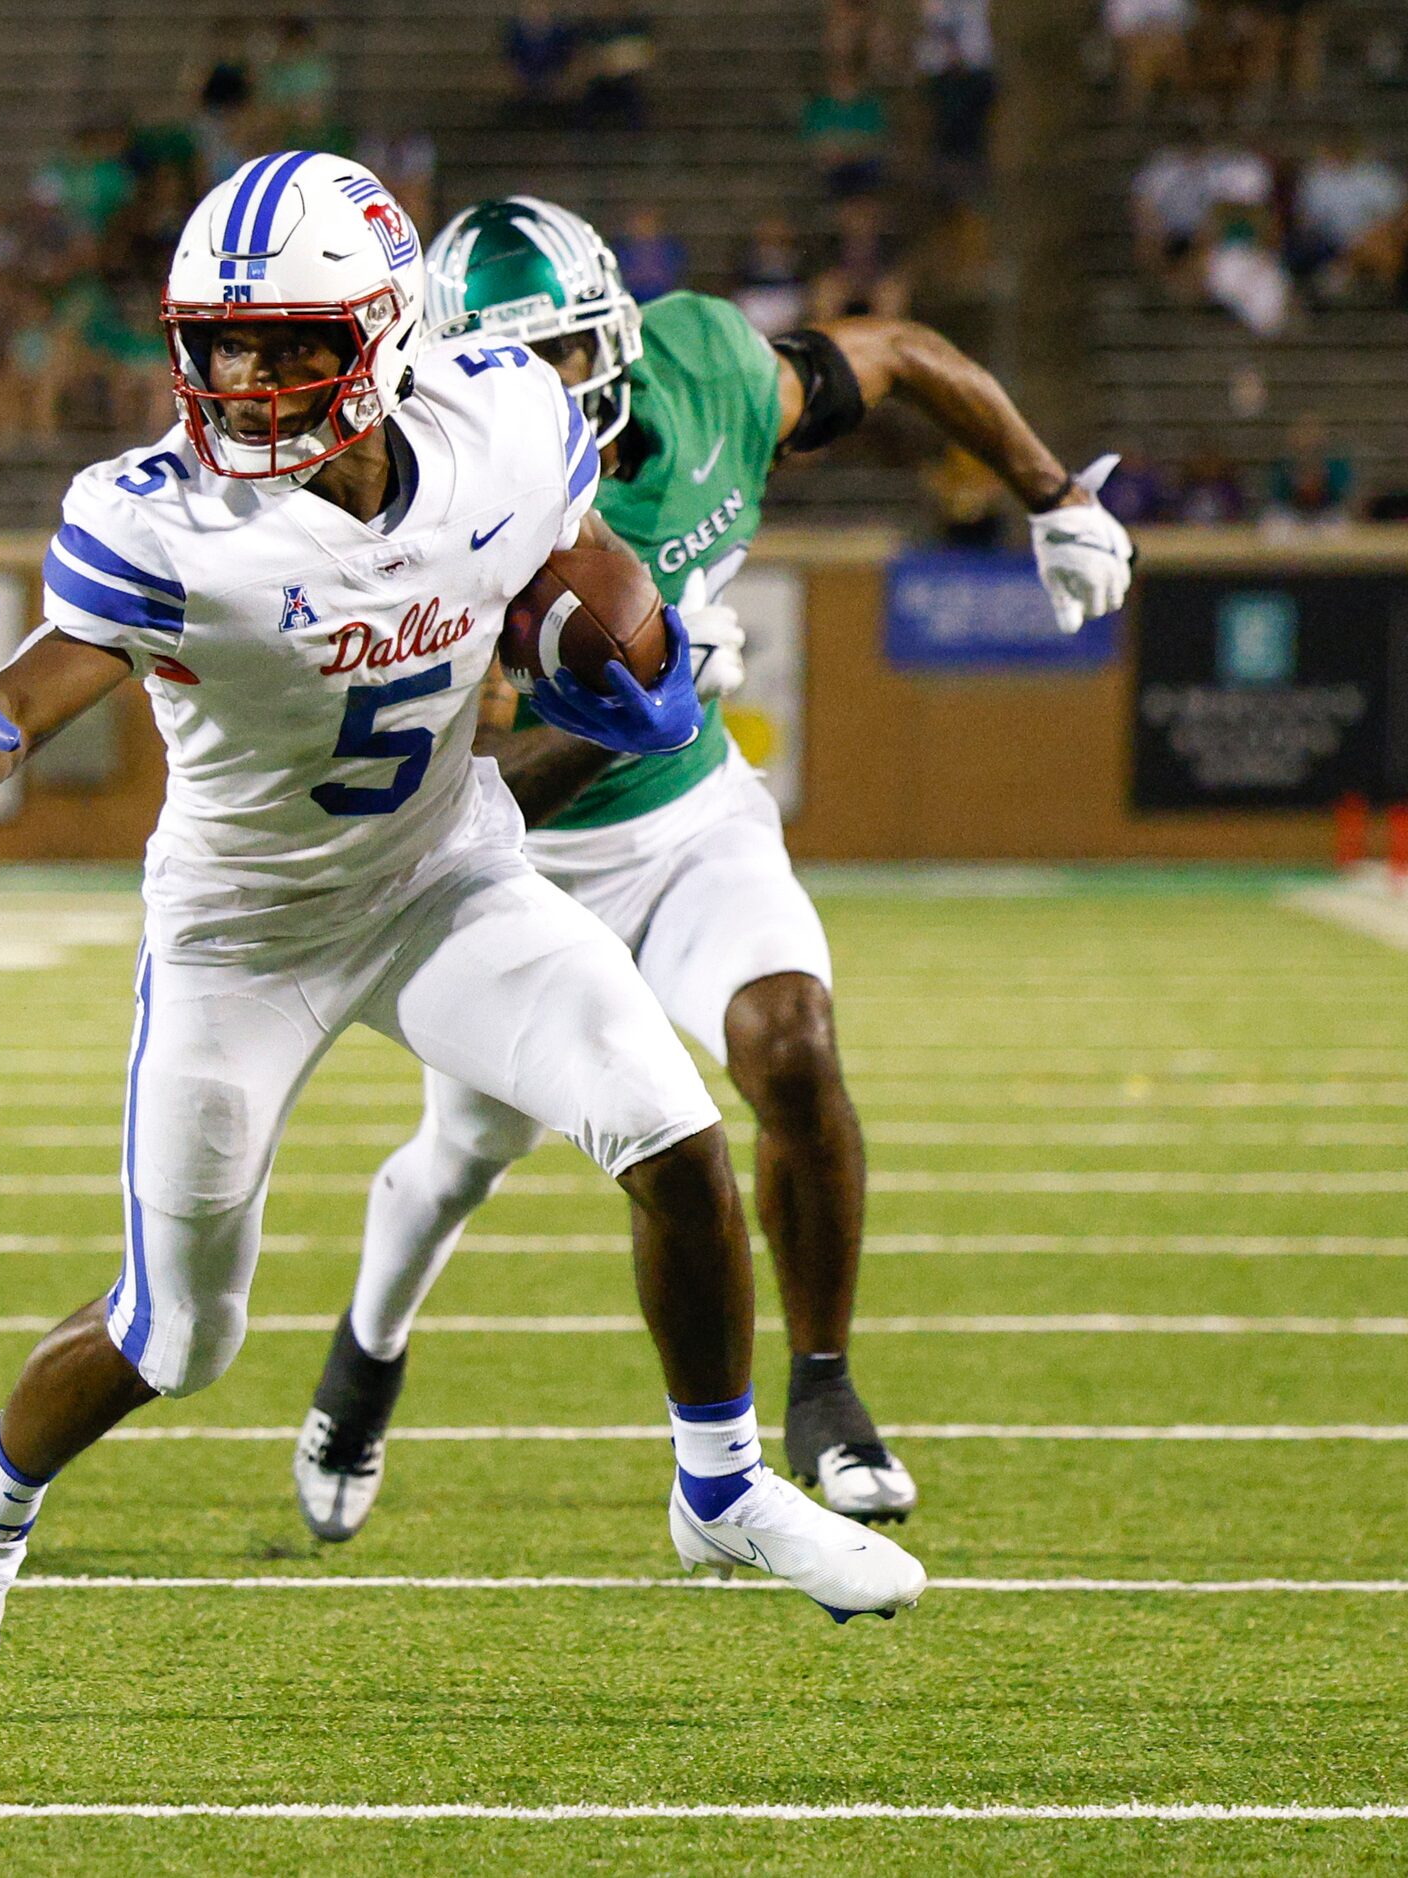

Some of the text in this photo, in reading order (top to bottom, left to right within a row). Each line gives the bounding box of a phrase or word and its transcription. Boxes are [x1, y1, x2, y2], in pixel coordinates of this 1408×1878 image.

[452, 346, 529, 378] 5
[115, 451, 190, 496] 5
[656, 487, 744, 575] GREEN
[320, 597, 475, 676] Dallas
[310, 660, 452, 816] 5
